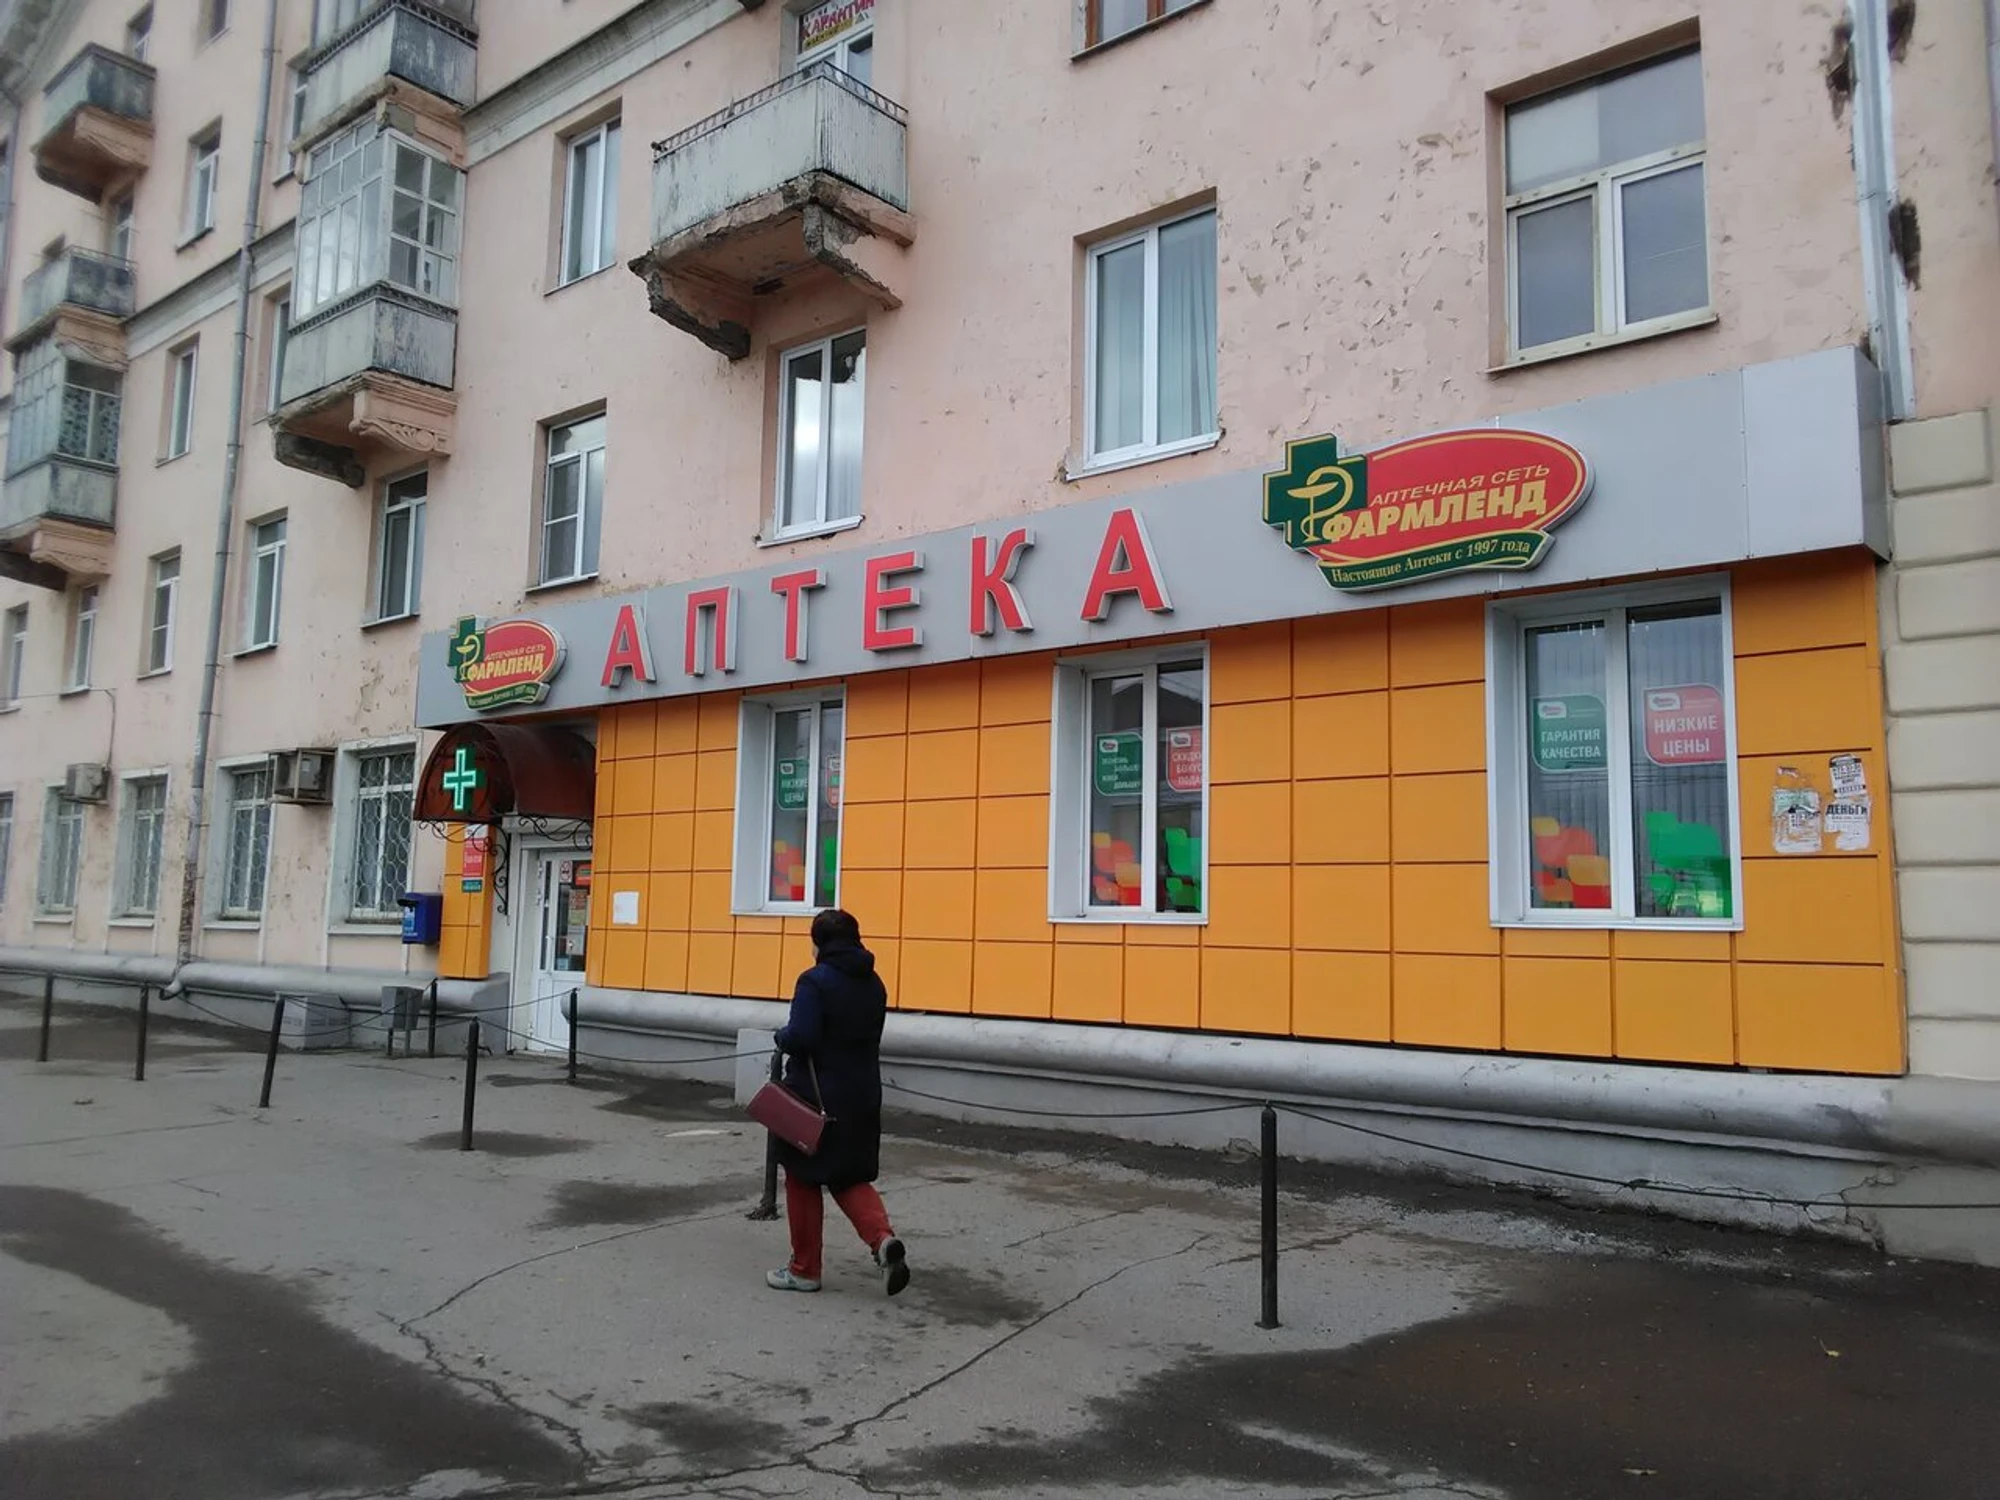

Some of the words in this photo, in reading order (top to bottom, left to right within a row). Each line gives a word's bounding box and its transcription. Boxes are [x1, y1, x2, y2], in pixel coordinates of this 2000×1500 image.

[1370, 474, 1485, 508] АПТЕЧНАЯ
[1490, 463, 1551, 485] СЕТЬ
[1321, 479, 1548, 543] ФАРМЛЕНД
[1331, 559, 1402, 584] Настоящие
[1404, 550, 1452, 573] Аптеки
[1454, 549, 1464, 560] с
[1466, 538, 1499, 558] 1997
[1501, 540, 1531, 554] года
[601, 507, 1174, 687] АПТЕКА
[467, 652, 545, 682] ФАРМЛЕНД
[1654, 714, 1719, 734] НИЗКИЕ
[1541, 728, 1601, 743] ГАРАНТИЯ
[1172, 751, 1202, 762] СКИДК
[1541, 744, 1602, 760] КАЧЕСТВА
[1663, 737, 1711, 757] ЦЕНЫ
[1176, 763, 1202, 774] БОНУС
